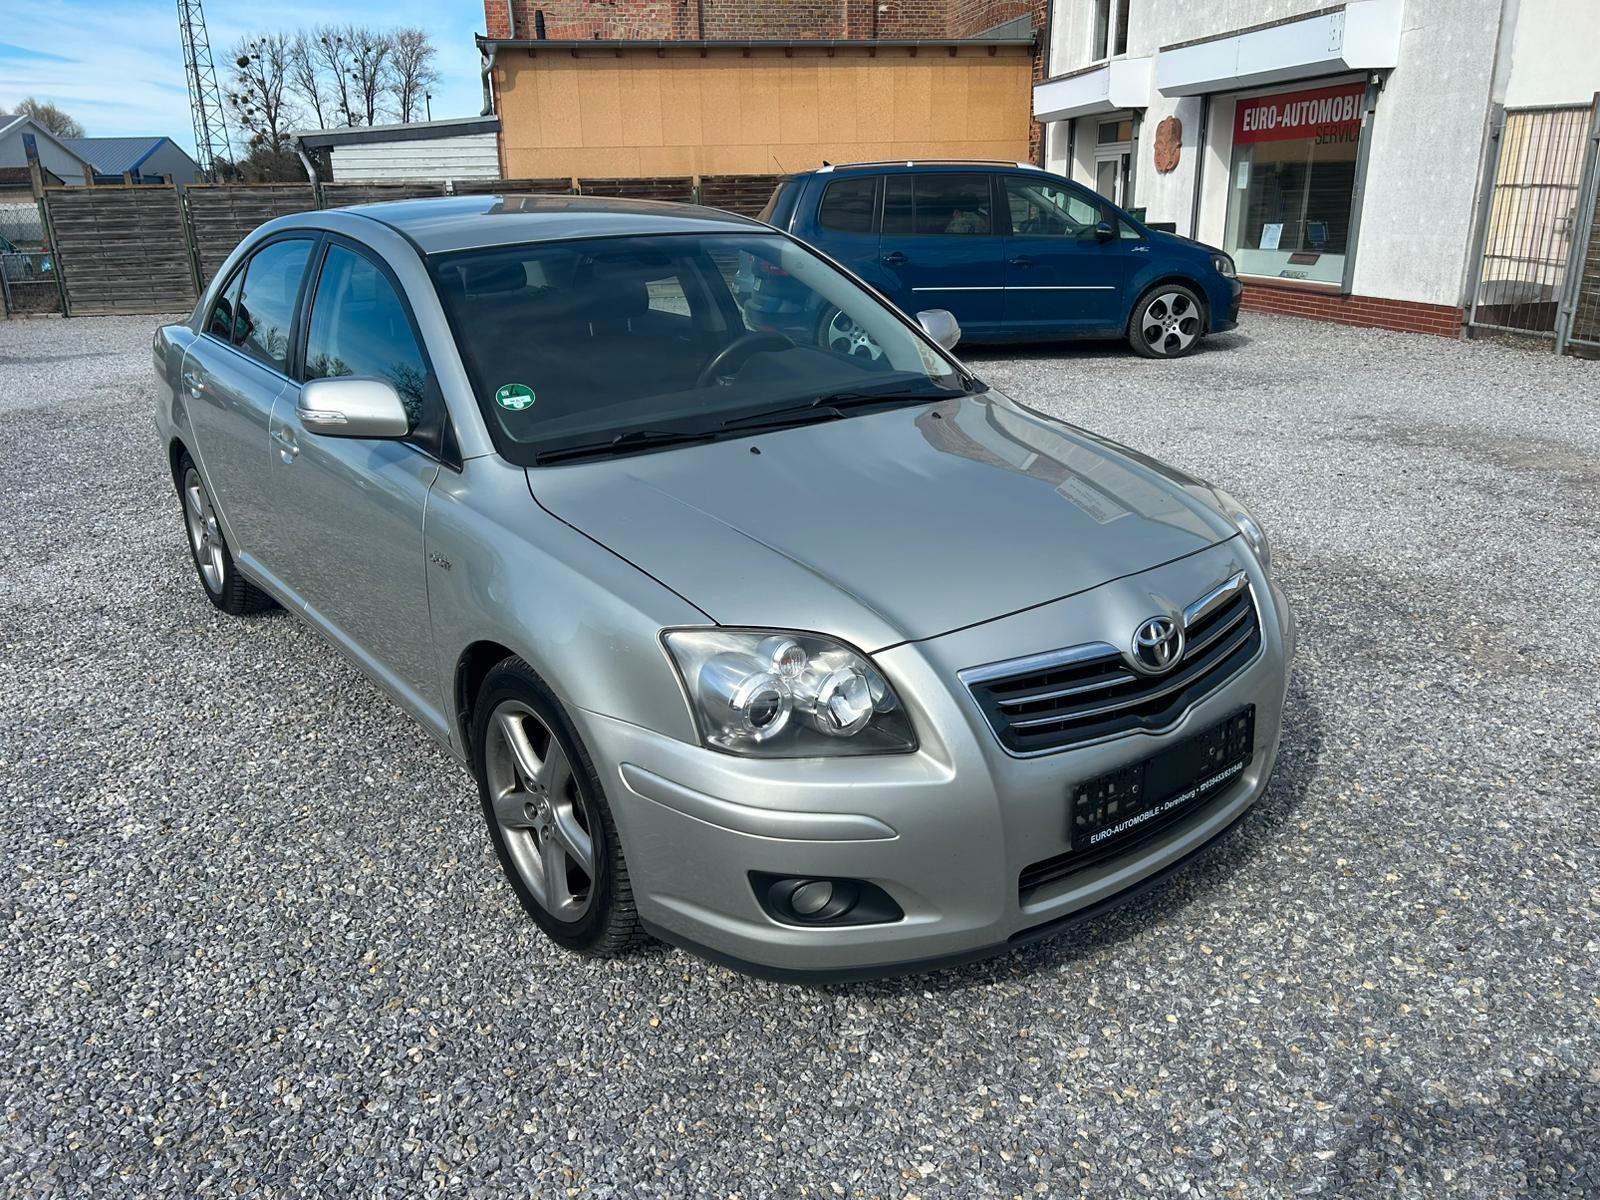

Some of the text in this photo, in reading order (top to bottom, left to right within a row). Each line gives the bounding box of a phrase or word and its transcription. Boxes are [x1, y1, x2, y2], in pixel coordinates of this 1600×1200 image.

[1315, 124, 1359, 145] SERVIC
[1090, 806, 1160, 844] EURO-AUTOMOBILE
[1164, 789, 1196, 811] Derenburg
